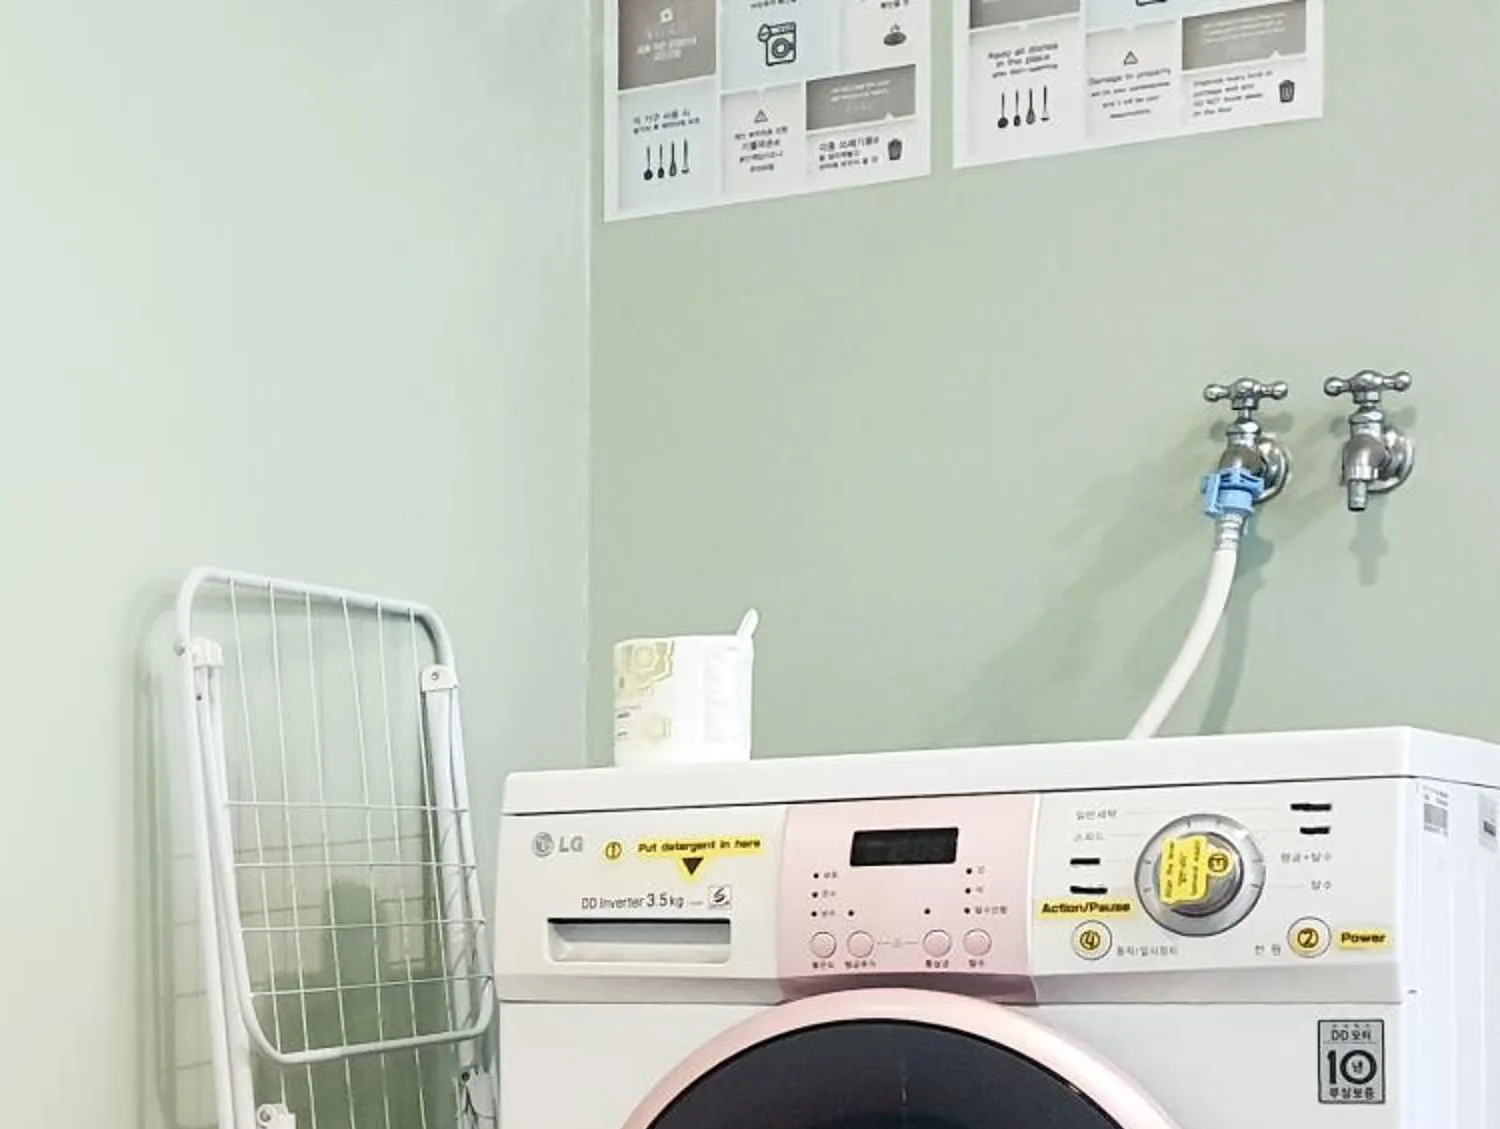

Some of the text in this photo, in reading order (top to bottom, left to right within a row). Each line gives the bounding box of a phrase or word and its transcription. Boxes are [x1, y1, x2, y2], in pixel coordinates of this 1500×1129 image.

[558, 836, 583, 852] LG
[638, 842, 657, 853] Put
[661, 840, 715, 853] detergent
[719, 839, 730, 849] in
[734, 838, 761, 849] here
[1042, 901, 1131, 913] Action/Pause
[1341, 931, 1386, 944] Power
